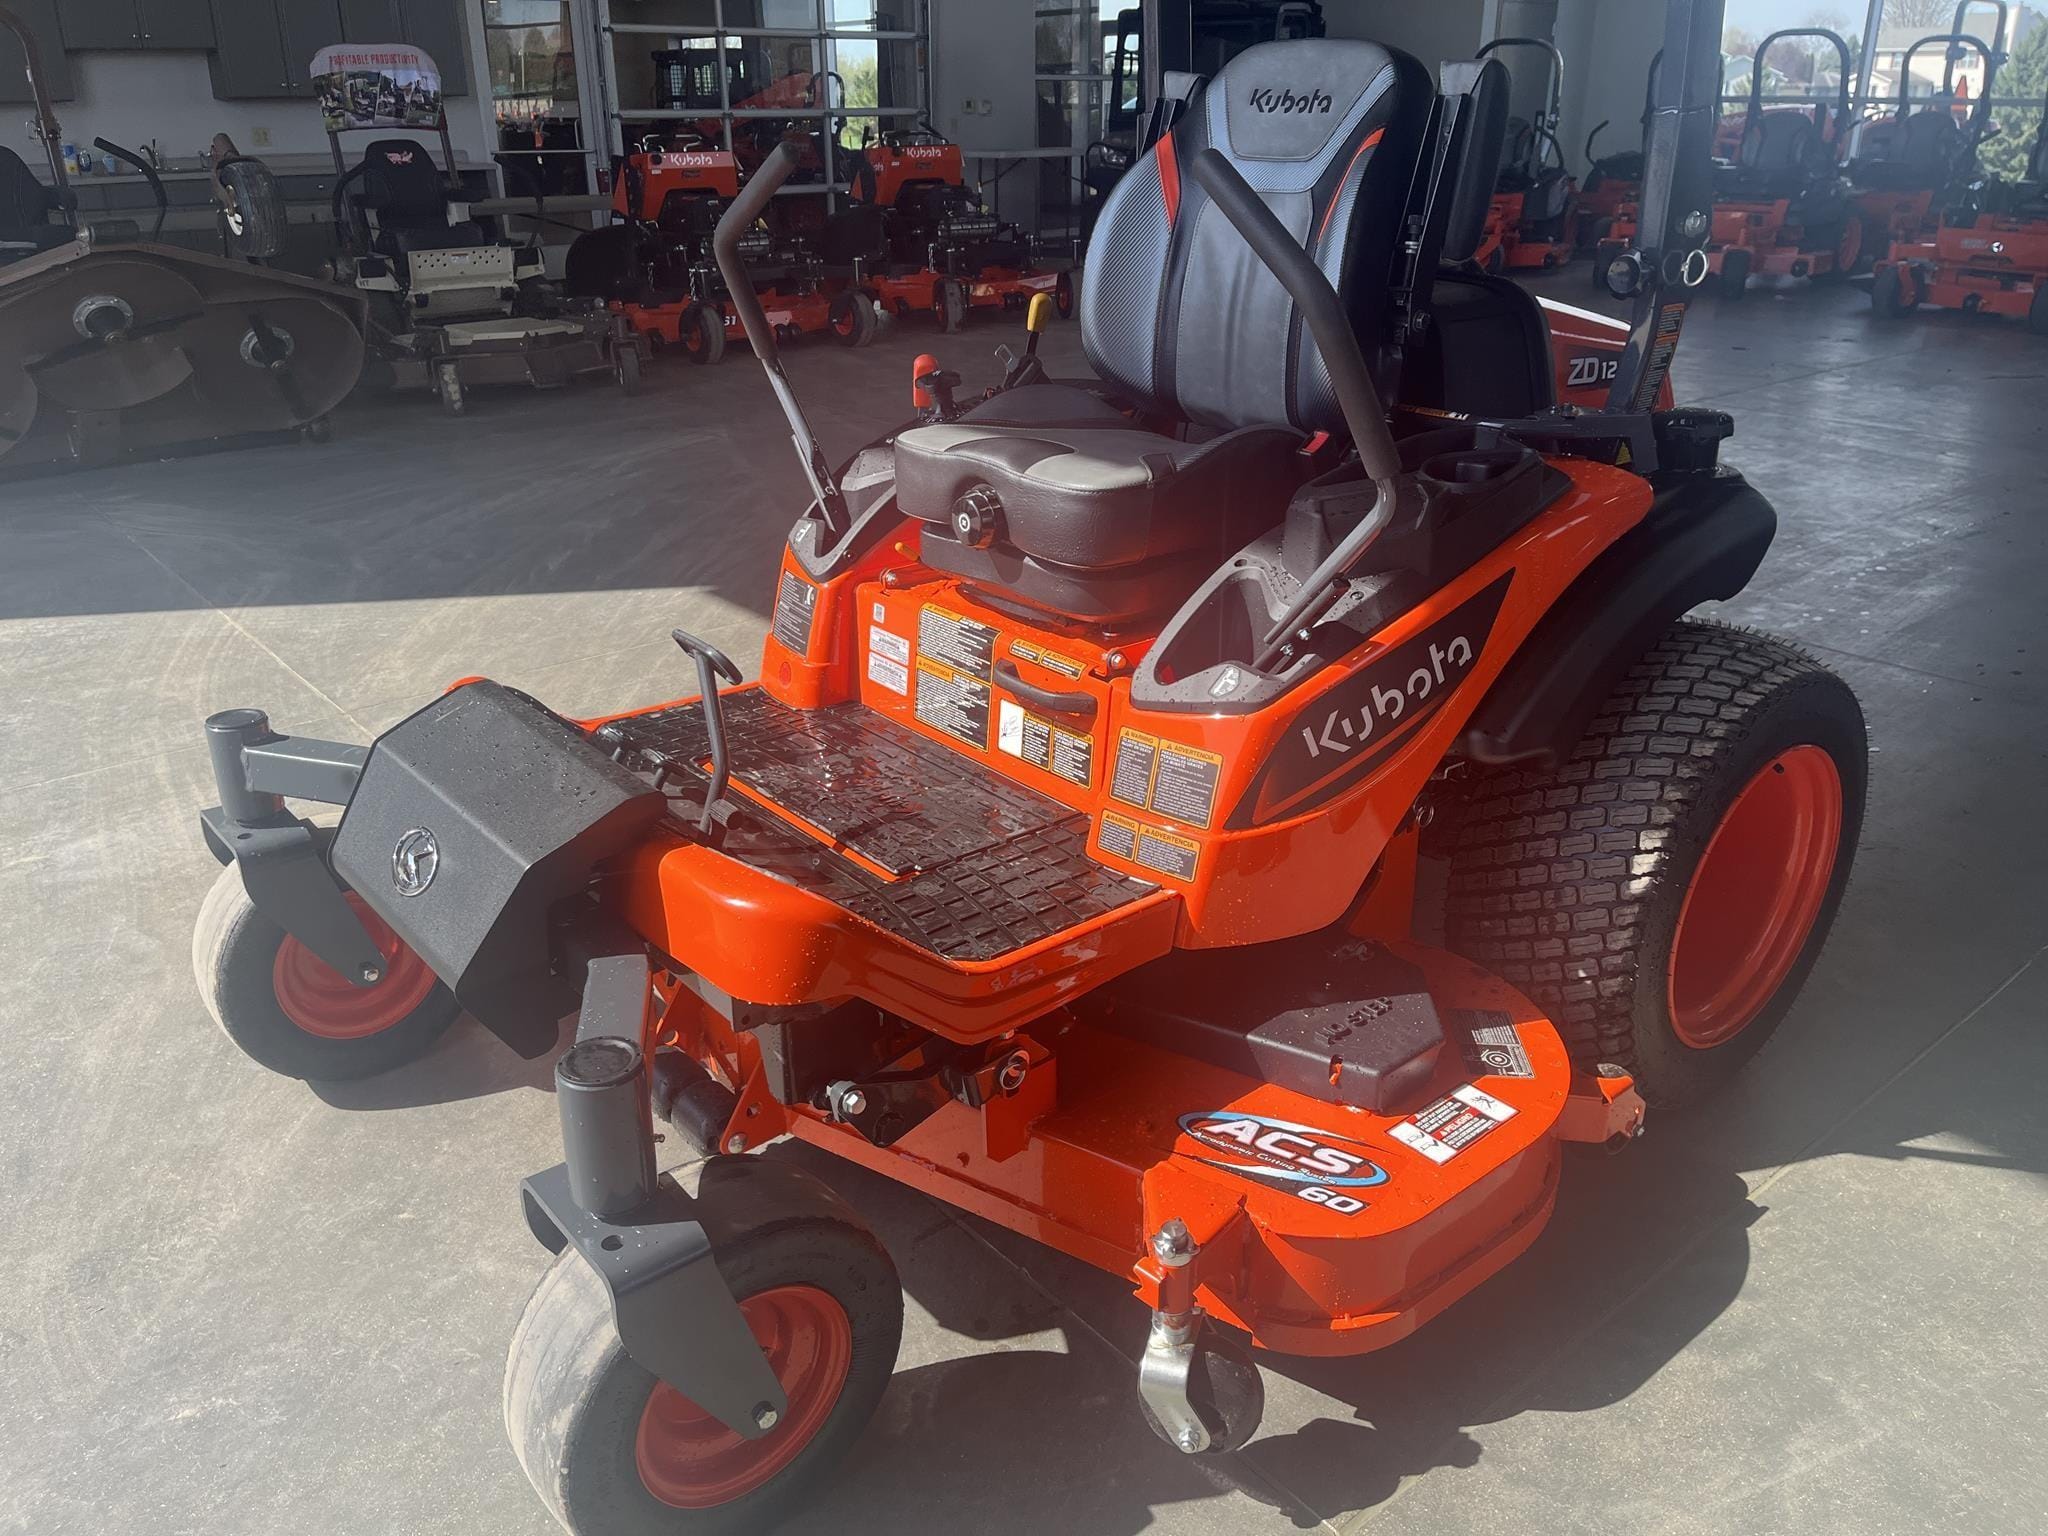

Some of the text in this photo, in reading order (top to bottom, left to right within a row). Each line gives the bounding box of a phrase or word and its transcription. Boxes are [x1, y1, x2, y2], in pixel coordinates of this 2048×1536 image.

[328, 54, 418, 66] PROFITABLE PRODUCTIVITY
[1249, 88, 1332, 114] Kubota
[670, 154, 712, 166] Kubota
[906, 146, 942, 158] Kubota
[1302, 636, 1472, 758] Kubota
[1130, 732, 1154, 744] WARNING
[1174, 745, 1214, 760] ADVERTENCIA
[1111, 815, 1135, 828] WARNING
[1151, 829, 1194, 848] ADVERTENCIA
[1348, 997, 1394, 1027] STEP
[1446, 1112, 1473, 1134] PELIGRO
[1202, 1118, 1364, 1174] ACS
[1192, 1132, 1337, 1185] Aerodynamic Cutting System
[1298, 1186, 1365, 1214] 60
